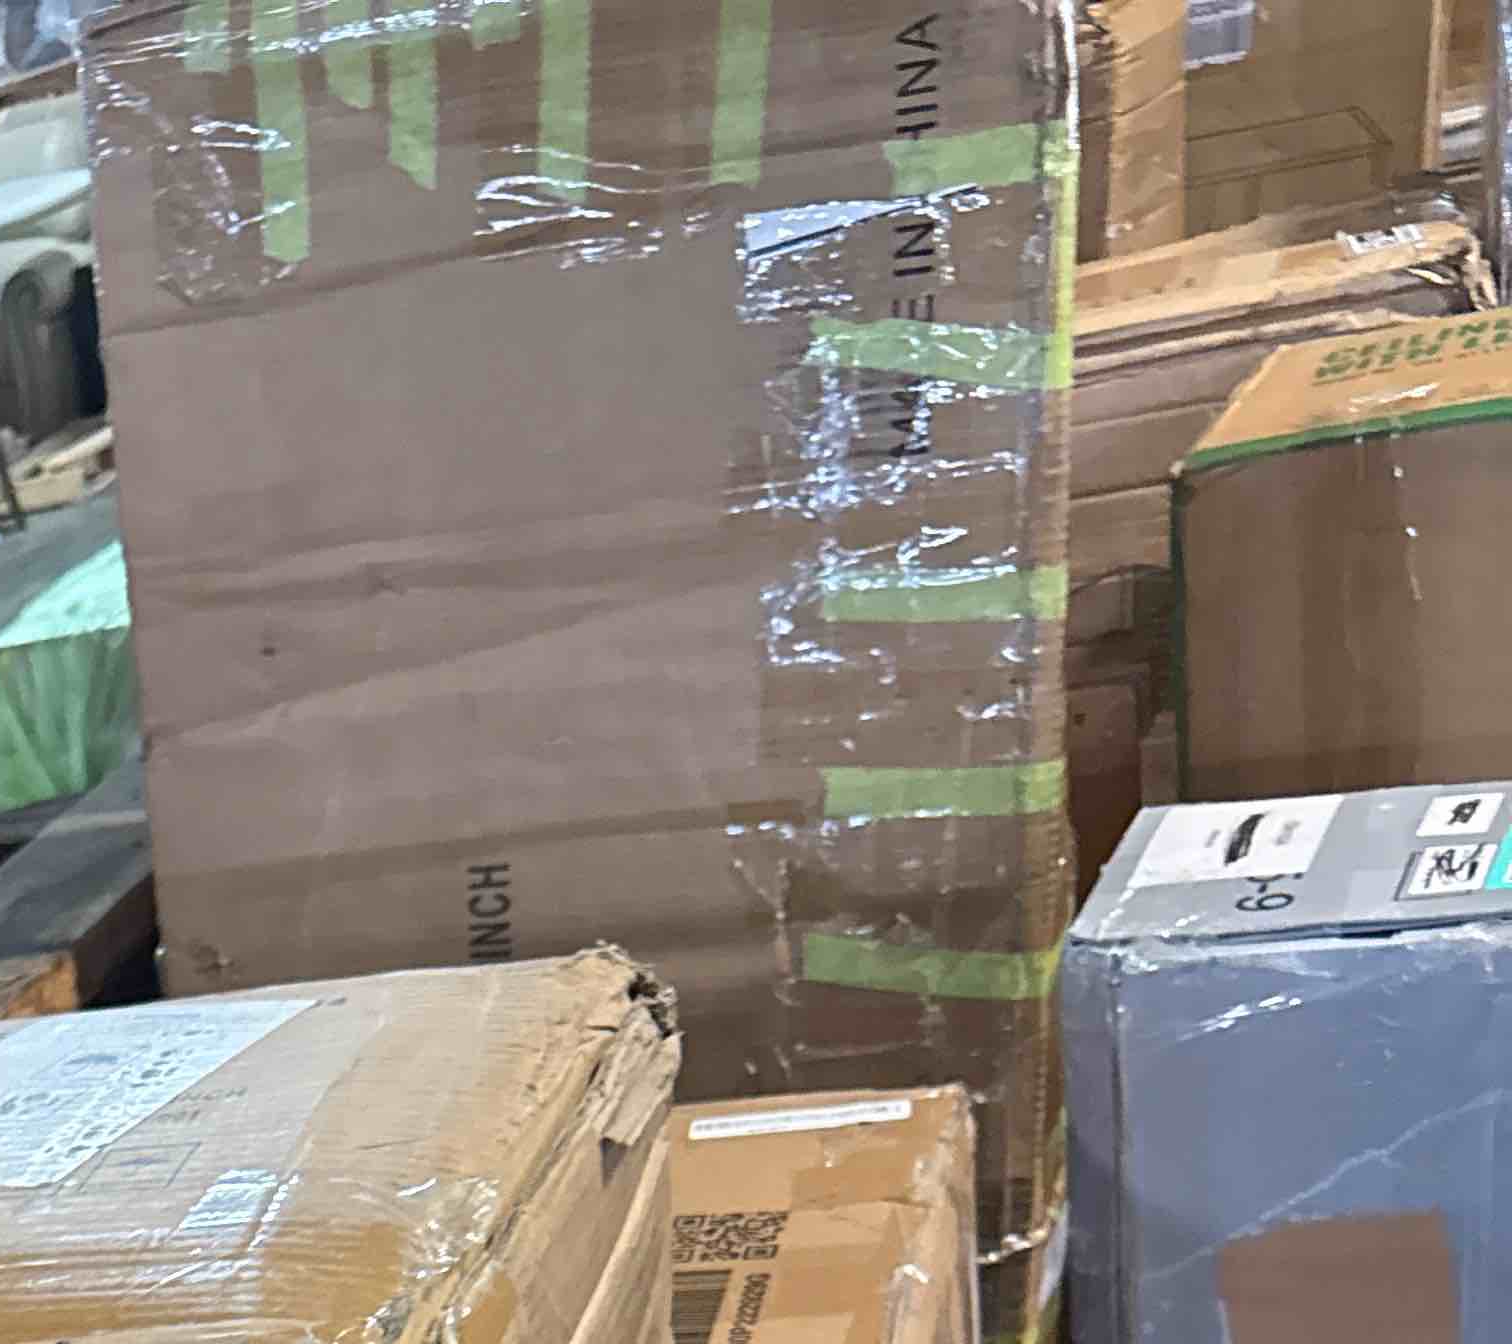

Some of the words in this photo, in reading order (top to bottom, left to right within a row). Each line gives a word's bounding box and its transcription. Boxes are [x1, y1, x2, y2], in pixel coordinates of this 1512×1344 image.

[894, 12, 940, 140] HINA
[892, 220, 936, 278] IN
[468, 860, 512, 960] INCH
